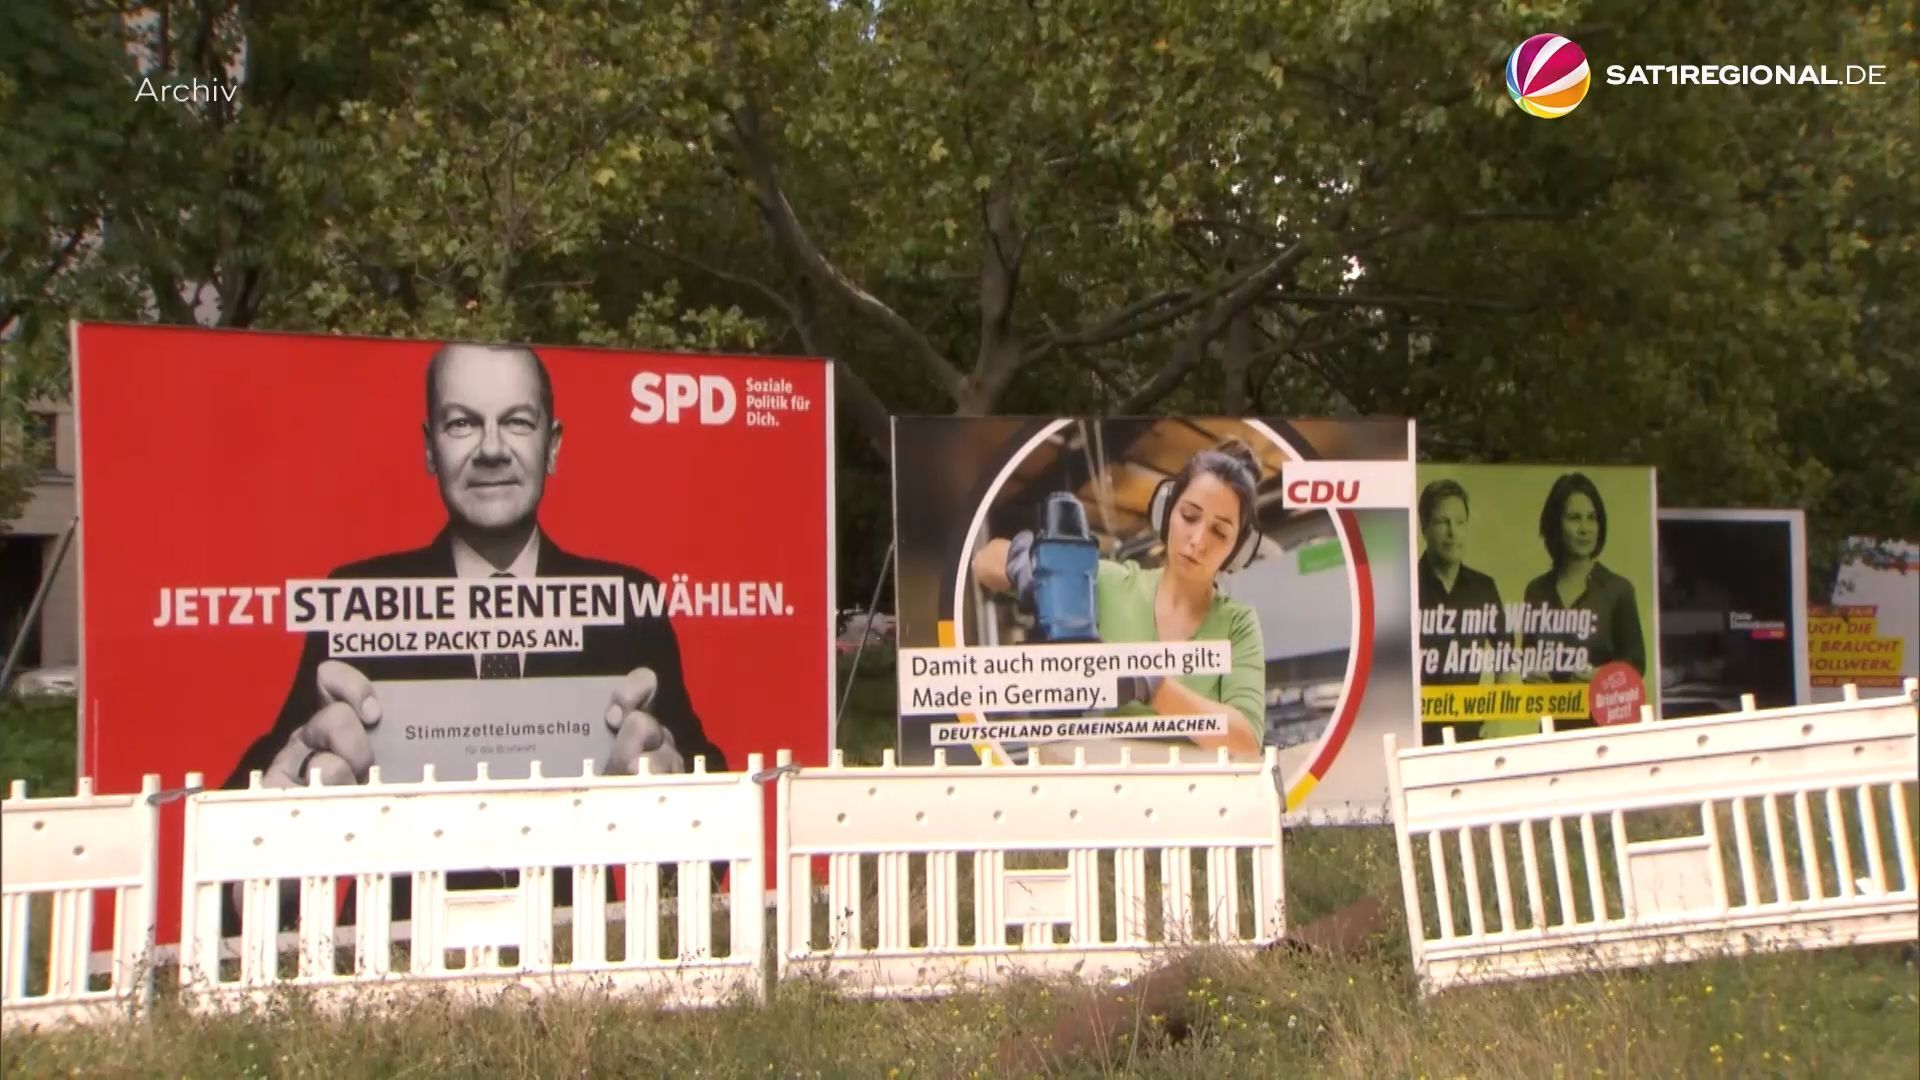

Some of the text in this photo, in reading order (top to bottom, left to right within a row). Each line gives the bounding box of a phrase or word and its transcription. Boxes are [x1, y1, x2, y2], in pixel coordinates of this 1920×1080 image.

[746, 377, 793, 393] Soziale
[630, 371, 737, 425] SPD
[746, 394, 811, 411] Politik für
[746, 411, 780, 427] Dich.
[1287, 480, 1360, 504] CDU
[153, 573, 795, 627] JETZT STABILE RENTEN WÄHLEN.
[1419, 602, 1598, 640] utz mit Wirkung:
[1847, 623, 1873, 635] DIE
[332, 629, 580, 653] SCHOLZ PACKT DAS AN.
[1820, 640, 1900, 652] BRAUCHT
[912, 648, 1221, 678] Damit auch morgen noch gilt:
[1443, 640, 1593, 678] Arbeitsplätze.
[912, 684, 1107, 709] Made in Germany.
[1464, 692, 1496, 714] weil
[1500, 691, 1522, 714] Ihr
[1525, 697, 1545, 713] es
[1549, 690, 1585, 713] seid.
[405, 720, 590, 740] Stimmzettelumschlag
[938, 719, 1221, 742] DEUTSCHLAND GEMEINSAM MACHEN.
